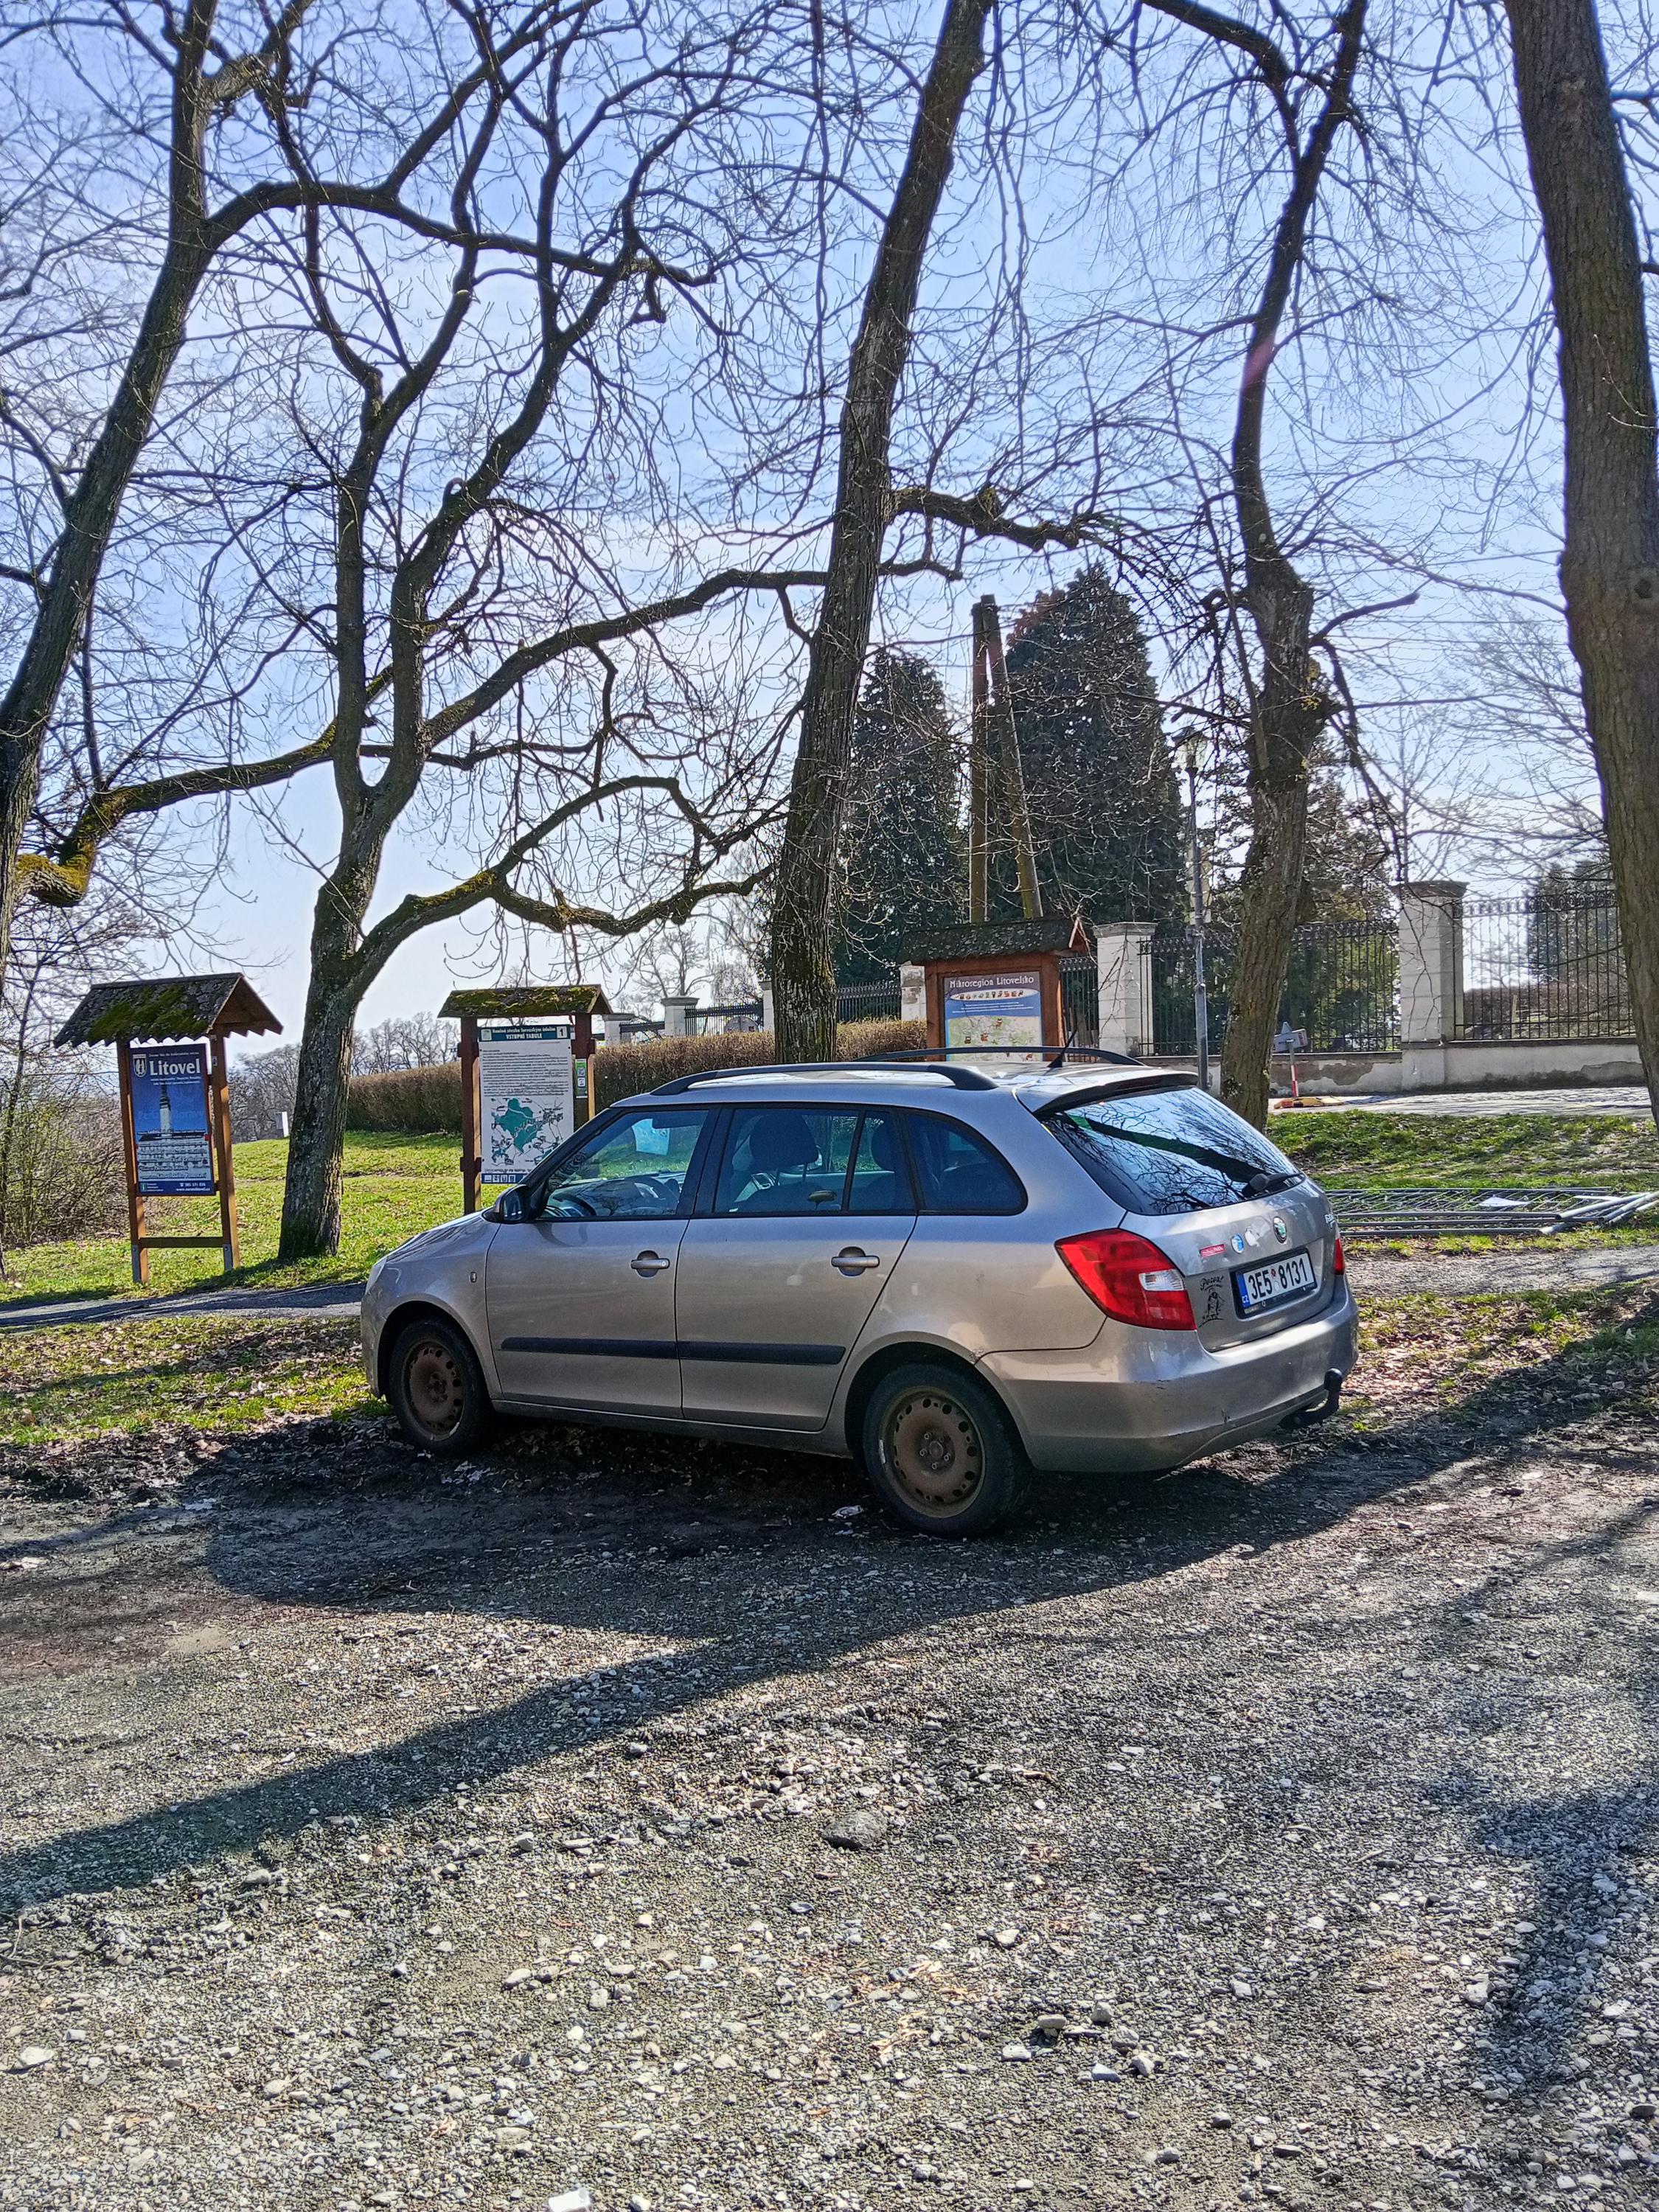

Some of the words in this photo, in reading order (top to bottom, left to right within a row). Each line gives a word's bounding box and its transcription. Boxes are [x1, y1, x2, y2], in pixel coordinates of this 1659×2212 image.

[950, 978, 993, 988] Mikroregion
[996, 975, 1034, 985] Litovelsko
[559, 1028, 564, 1036] 1
[149, 1058, 201, 1076] Litovel
[1248, 1270, 1273, 1300] 3E5
[1278, 1257, 1308, 1290] 8131
[1242, 1294, 1250, 1304] CZ
